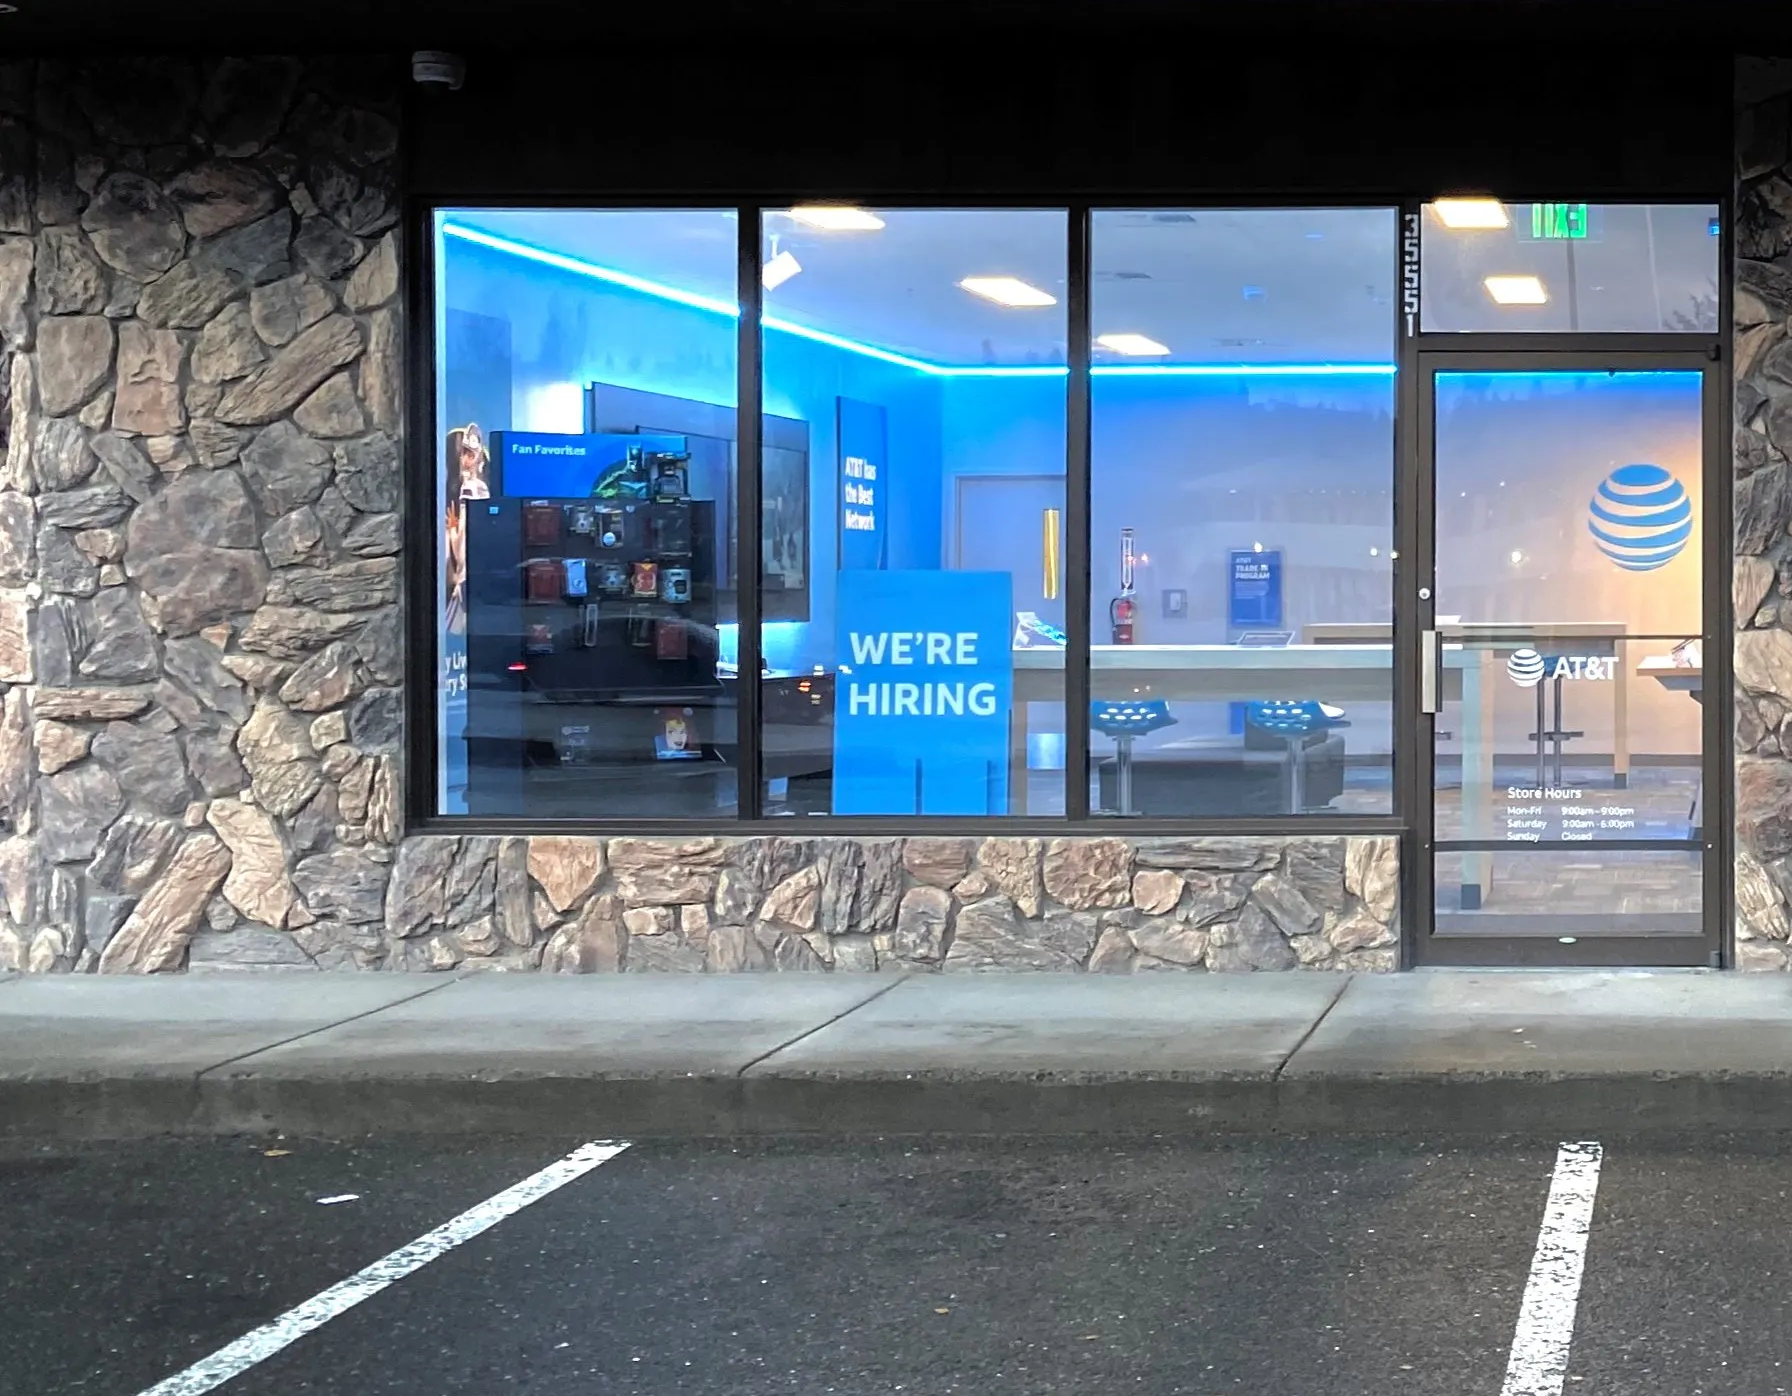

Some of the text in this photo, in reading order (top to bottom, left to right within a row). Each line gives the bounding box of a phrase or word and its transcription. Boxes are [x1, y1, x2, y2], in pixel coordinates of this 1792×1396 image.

[1404, 213, 1419, 337] 35551
[512, 444, 586, 456] Fan Favorites
[849, 632, 979, 665] WE'RE
[1552, 656, 1620, 680] AT&T
[849, 682, 997, 716] HIRING
[1507, 787, 1582, 799] Store Hours
[1507, 806, 1542, 815] Mon-Fri
[1507, 819, 1547, 830] Saturday
[1507, 832, 1593, 843] Sunday Closed
